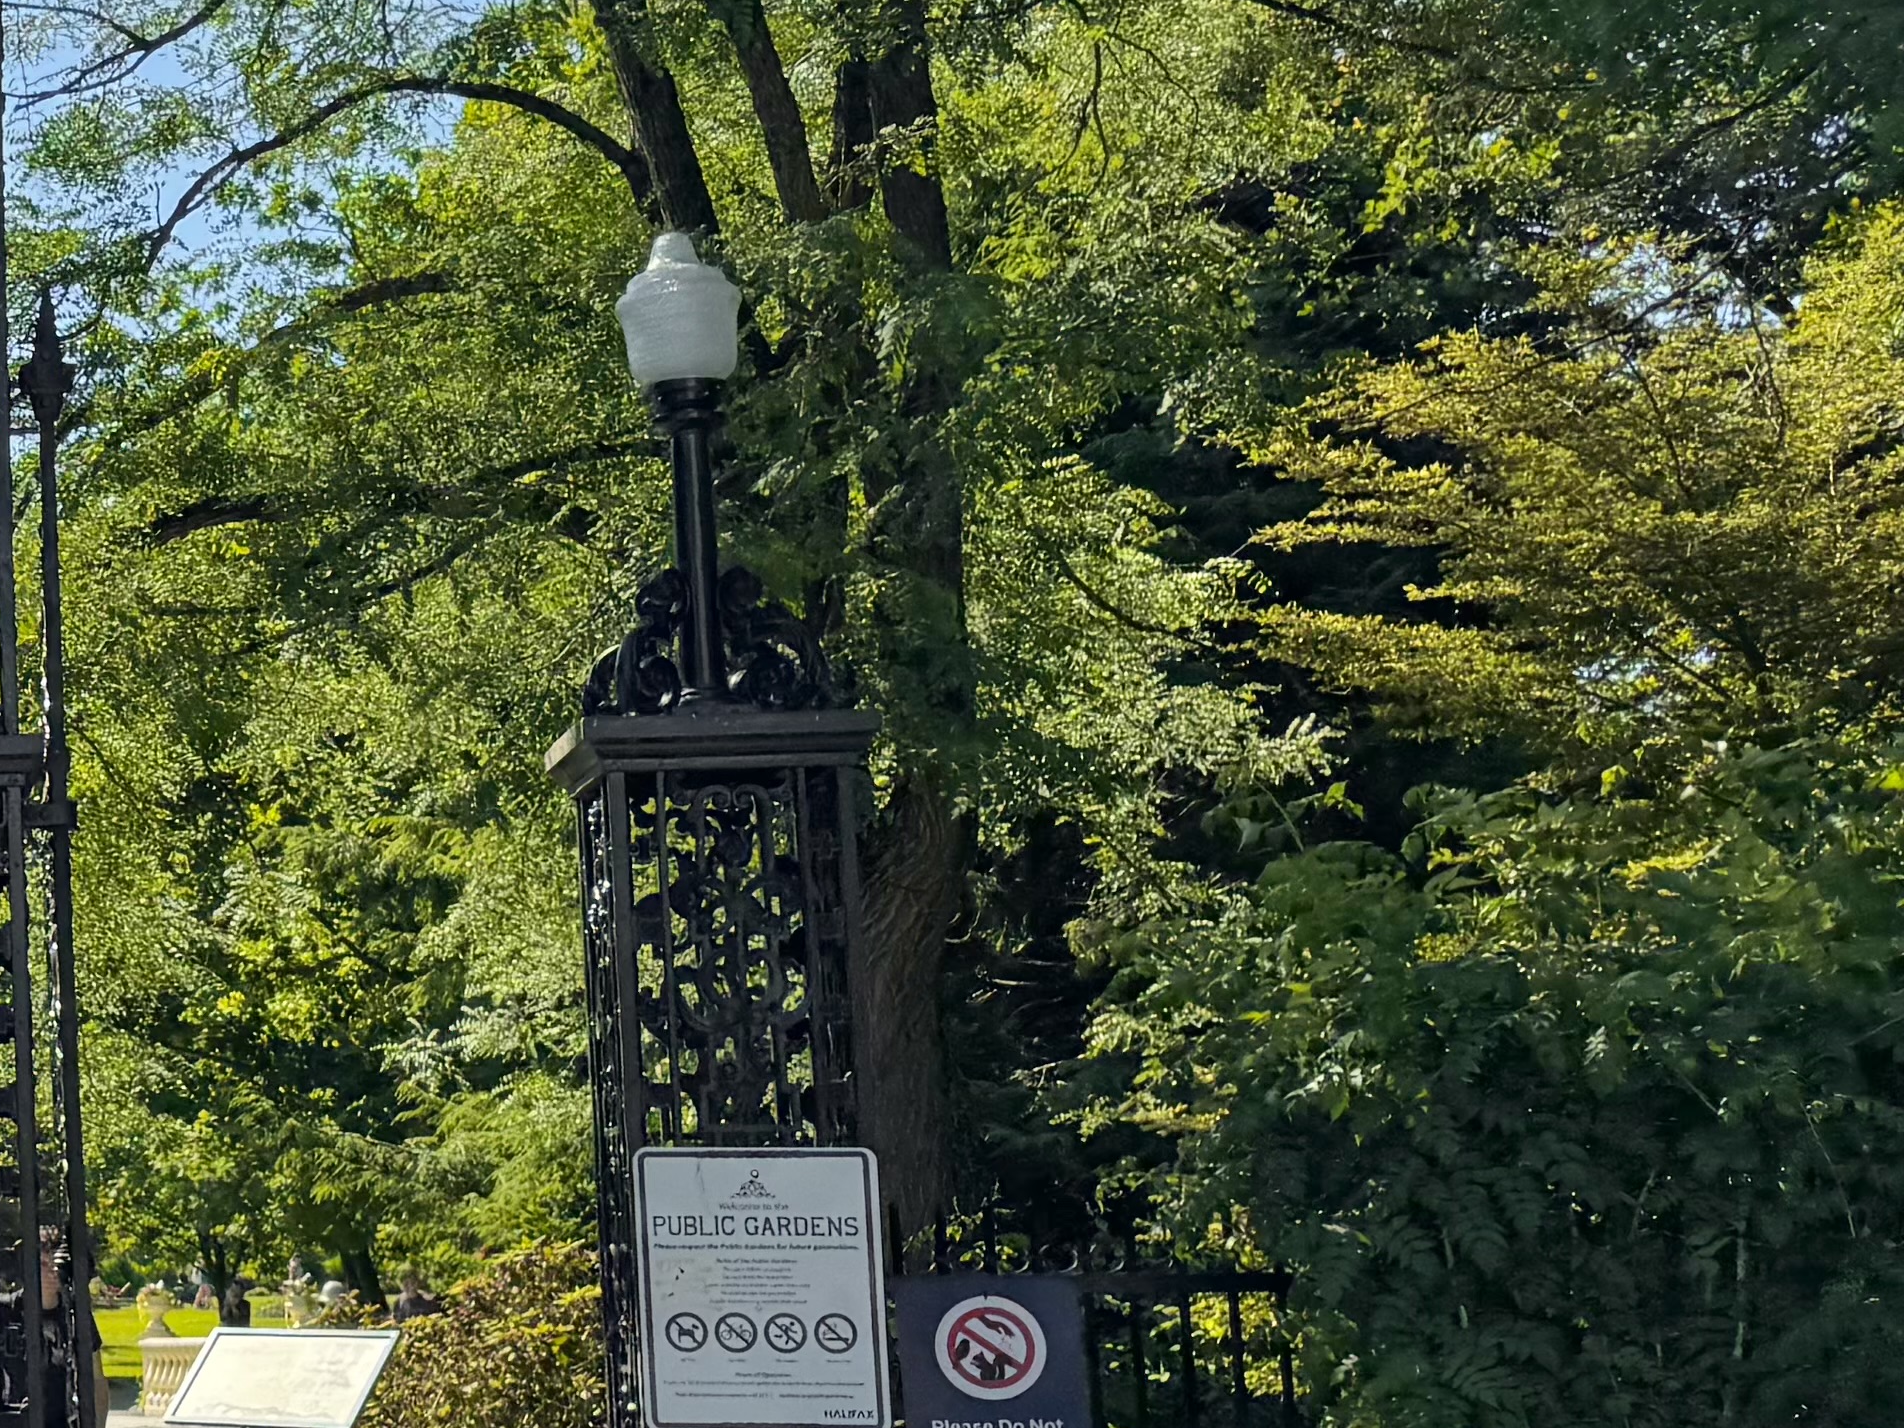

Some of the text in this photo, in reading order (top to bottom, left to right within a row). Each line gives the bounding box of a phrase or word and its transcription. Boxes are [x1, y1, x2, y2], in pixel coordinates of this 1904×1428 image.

[652, 1215, 859, 1237] PUBLIC GARDENS
[824, 1409, 874, 1420] HALIFAX
